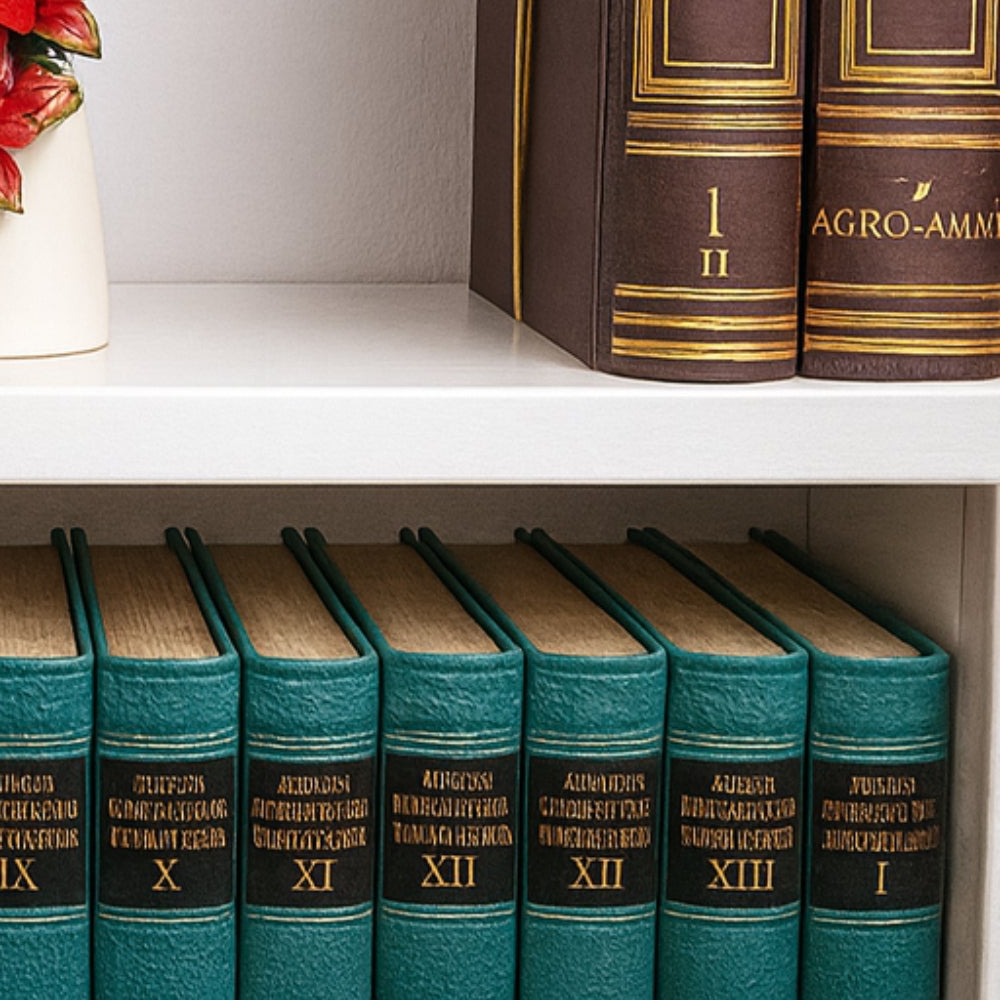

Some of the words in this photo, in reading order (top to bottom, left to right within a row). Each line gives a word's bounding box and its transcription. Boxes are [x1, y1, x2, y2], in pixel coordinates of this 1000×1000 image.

[0, 857, 40, 892] IX
[151, 858, 182, 892] X
[291, 858, 339, 892] XI
[421, 853, 479, 888] XII
[567, 856, 625, 890] XII
[706, 858, 775, 892] XIII
[874, 861, 890, 896] I
